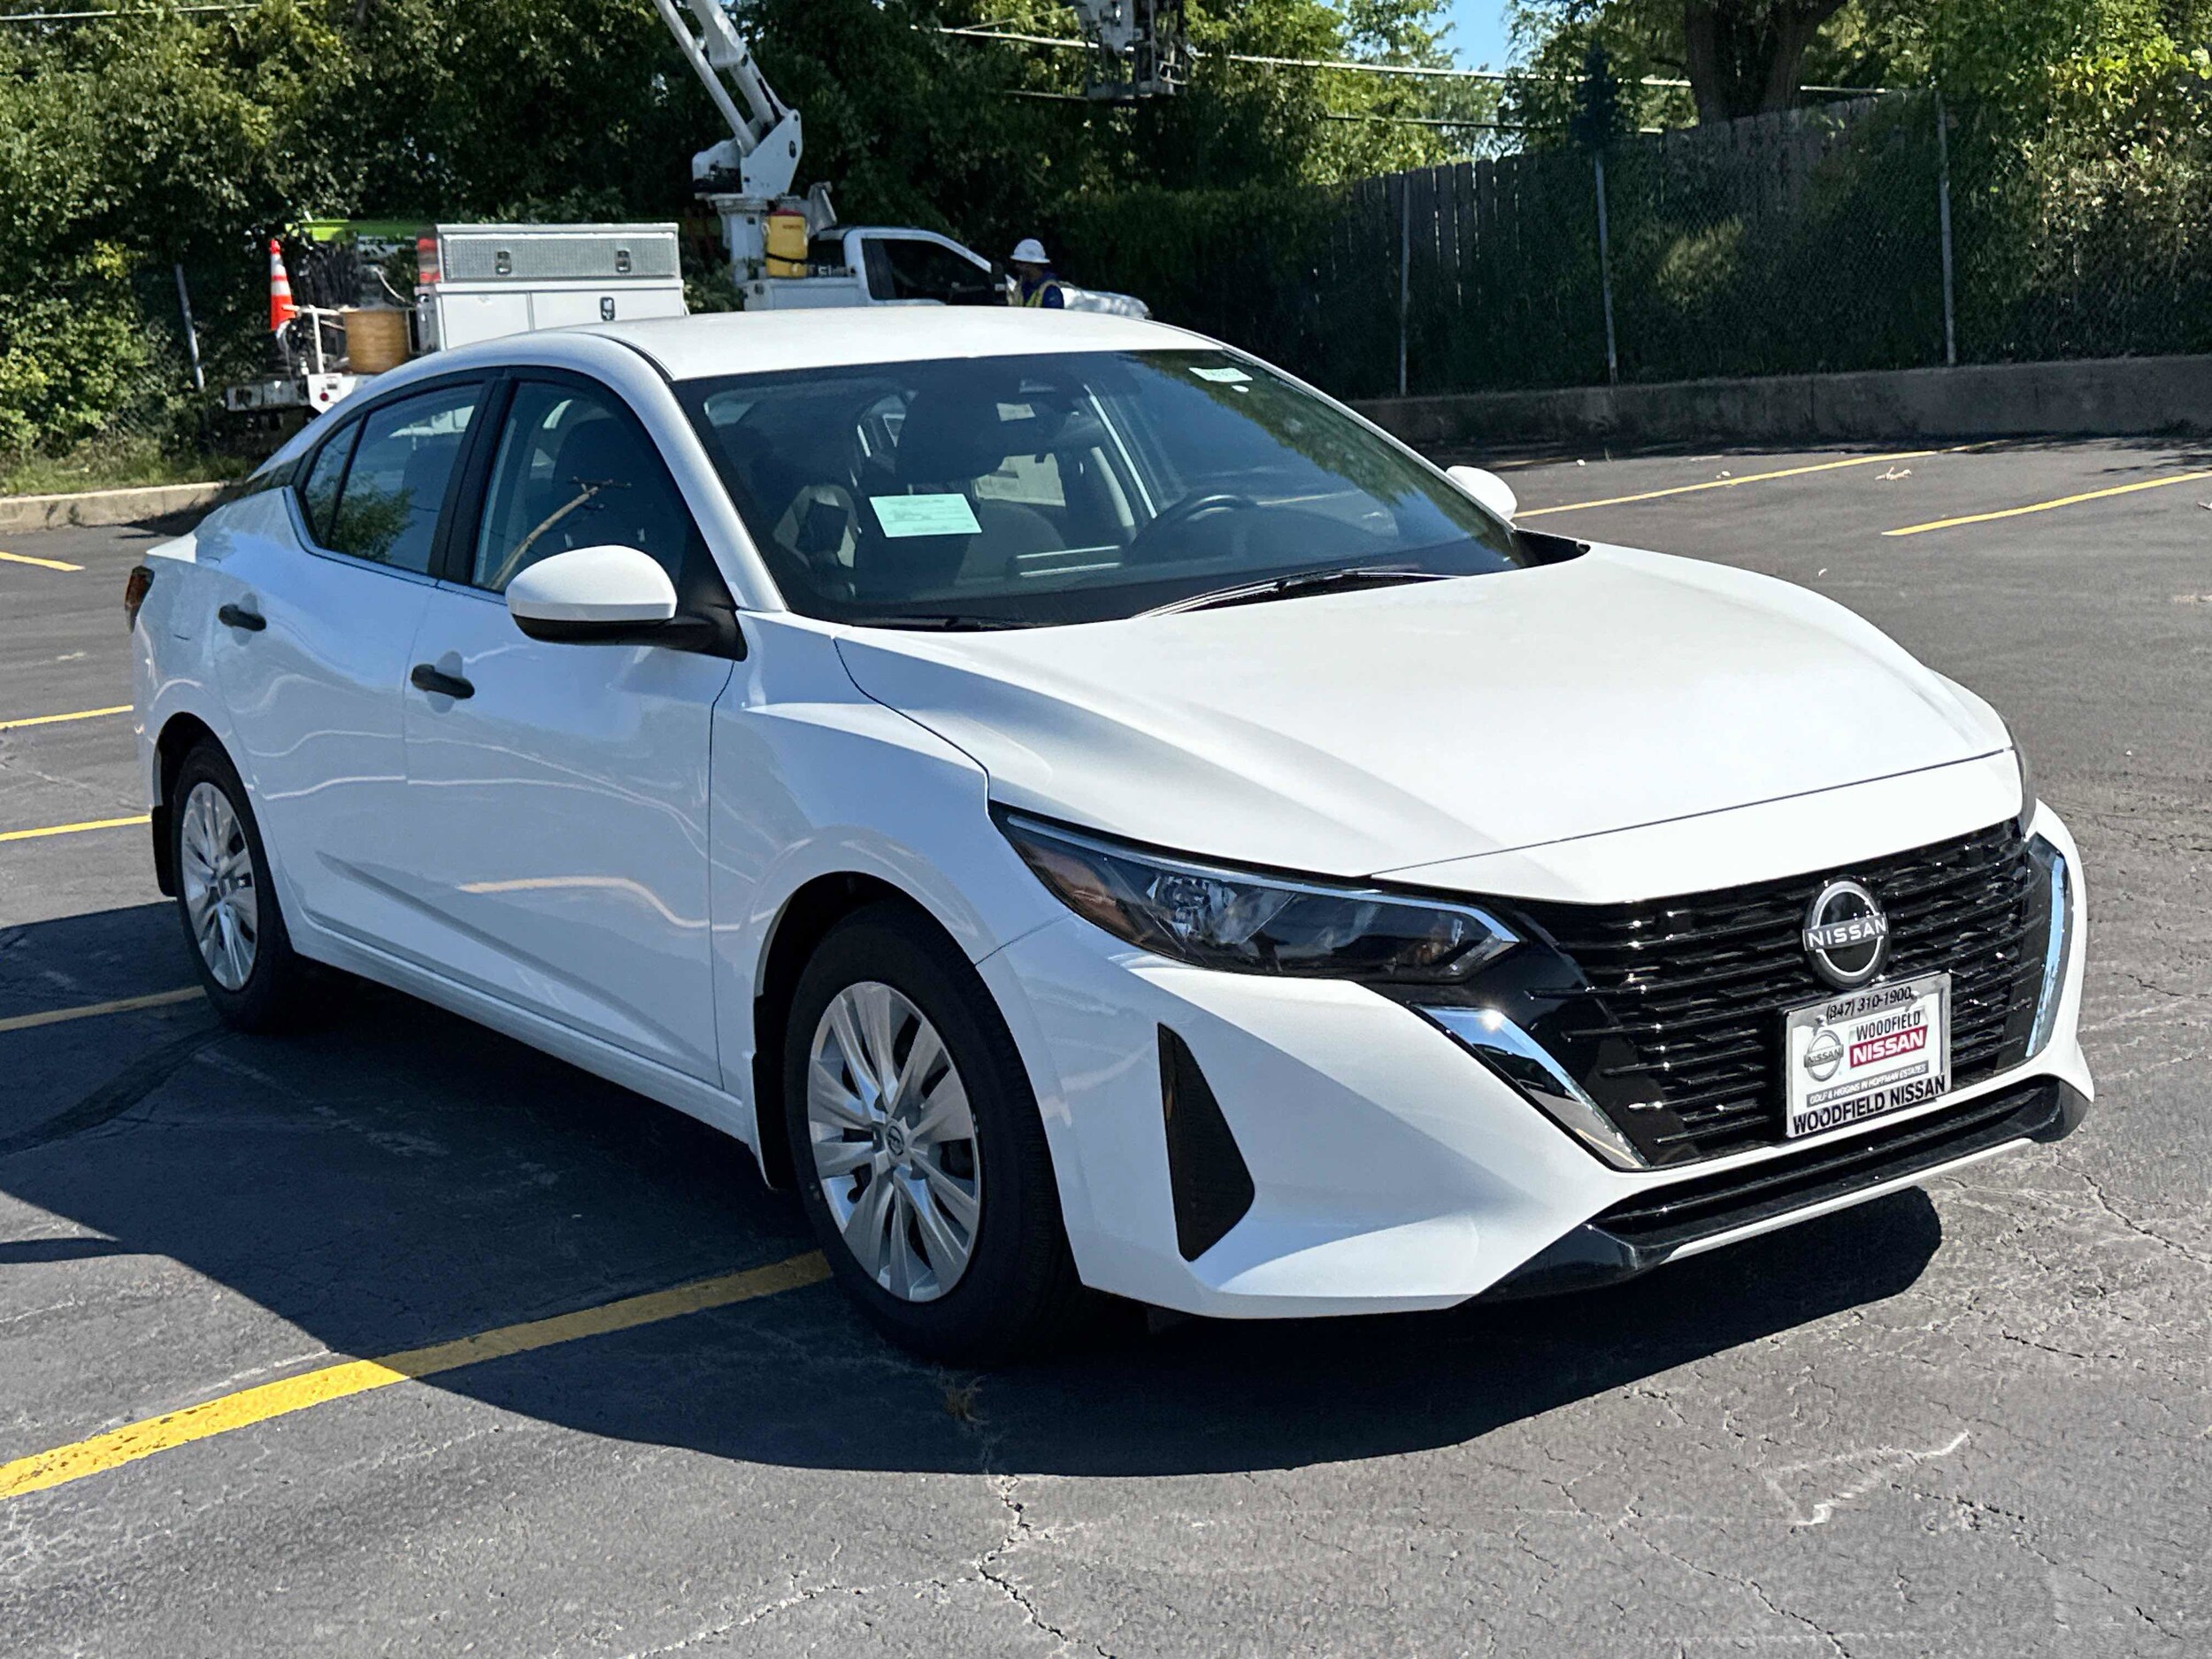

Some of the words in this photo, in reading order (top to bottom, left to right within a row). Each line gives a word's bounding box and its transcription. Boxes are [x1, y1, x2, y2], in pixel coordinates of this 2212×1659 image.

[1808, 918, 1886, 948] NISSAN
[1826, 999, 1855, 1020] (847)
[1857, 986, 1912, 1012] 310-1900
[1856, 1010, 1921, 1041] WOODFIELD
[1807, 1048, 1842, 1063] NISSAN
[1853, 1030, 1924, 1064] NISSAN
[1793, 1092, 1885, 1134] WOODFIELD
[1890, 1075, 1946, 1105] NISSAN
